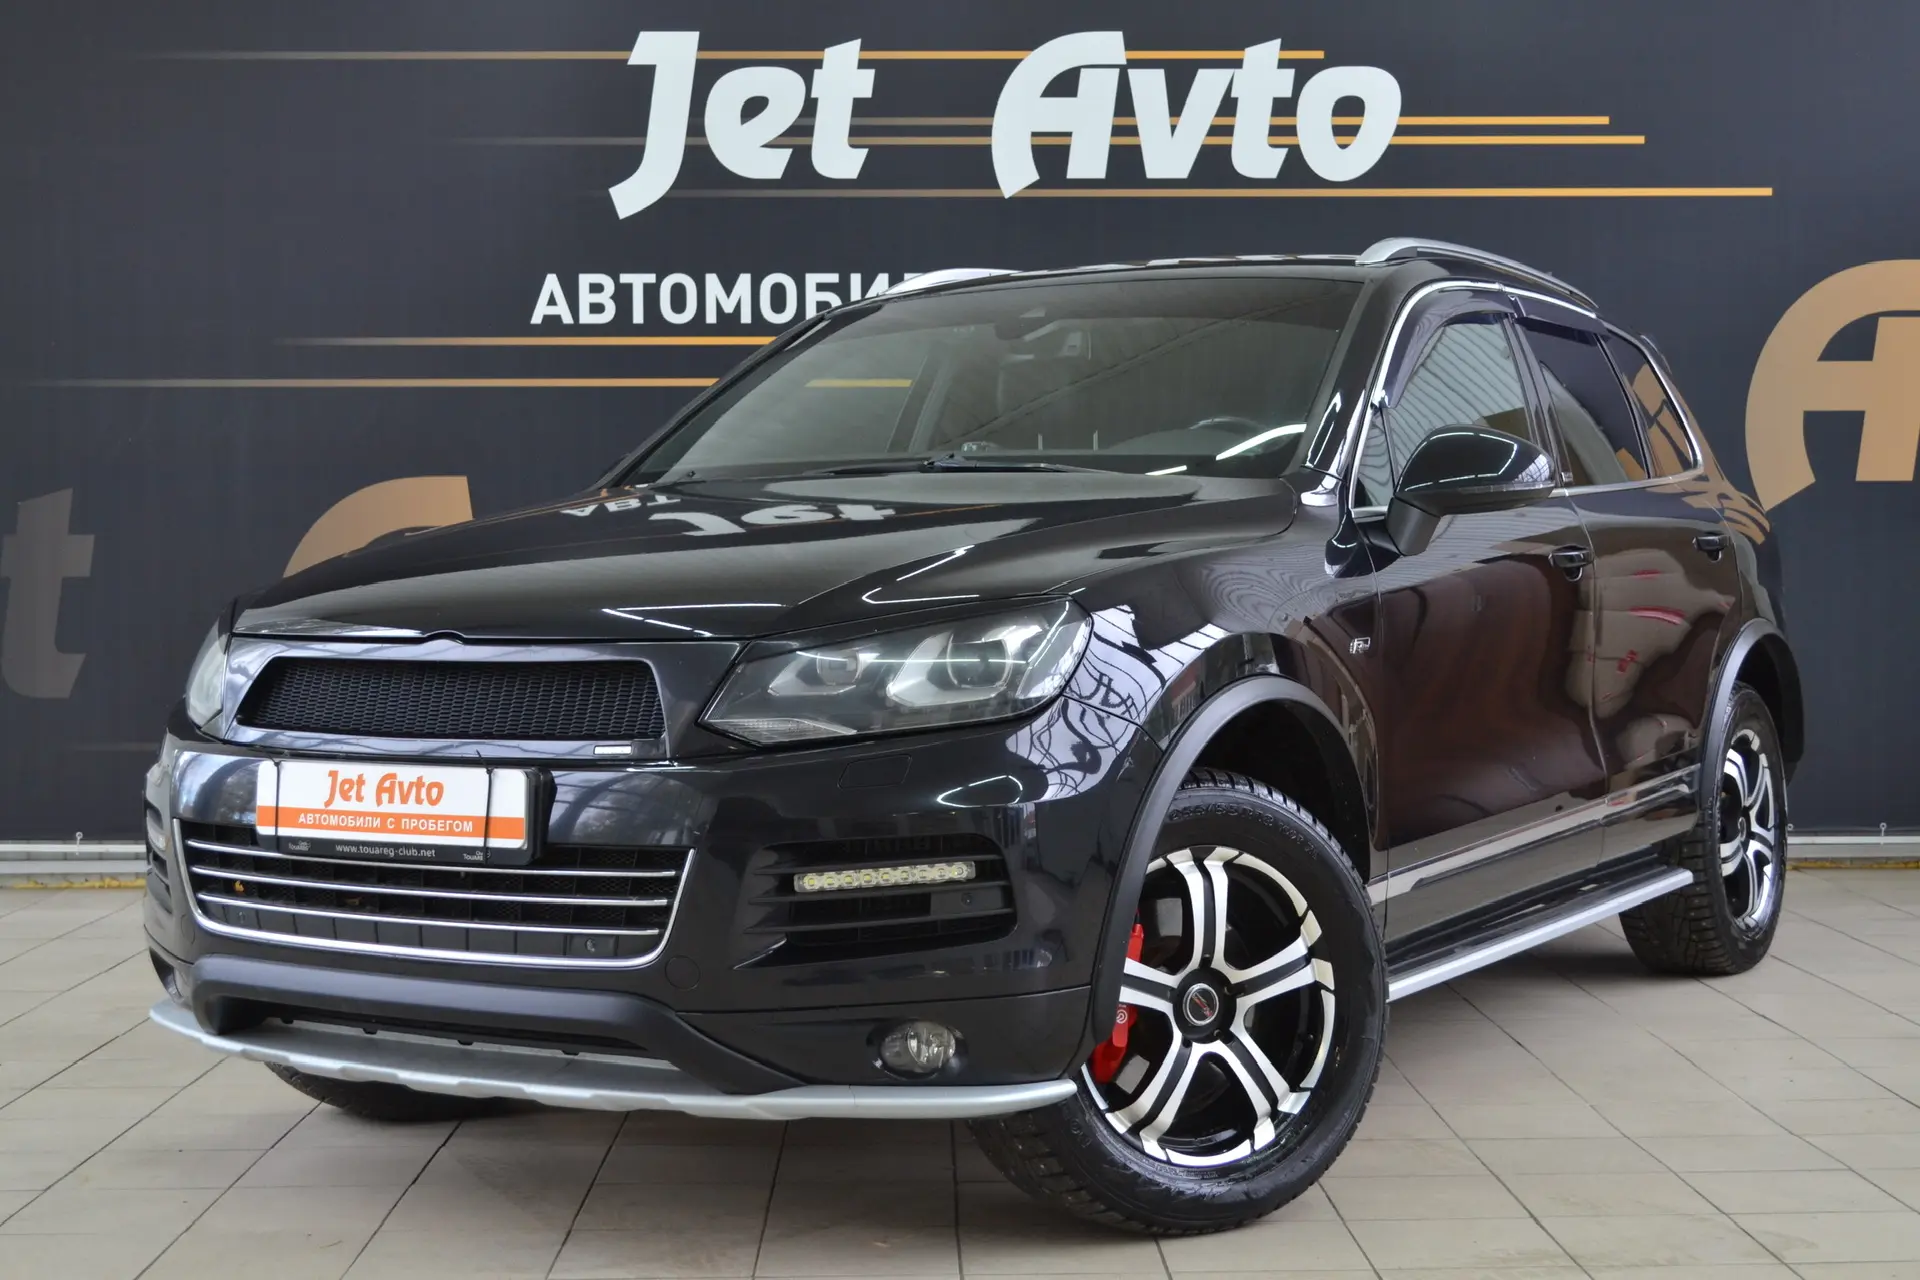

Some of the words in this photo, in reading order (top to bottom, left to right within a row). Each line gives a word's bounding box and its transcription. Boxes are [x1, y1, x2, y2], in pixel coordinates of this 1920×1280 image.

[608, 31, 876, 220] Jet
[991, 31, 1402, 199] Avto
[530, 272, 929, 325] АВТОМОБИ
[324, 770, 366, 808] Jet
[375, 772, 445, 807] Avto
[298, 812, 381, 829] АВТОМОБИЛИ
[387, 817, 396, 829] С
[401, 818, 473, 833] ПРОБЕГОМ
[335, 843, 436, 858] www.touareg-club.net
